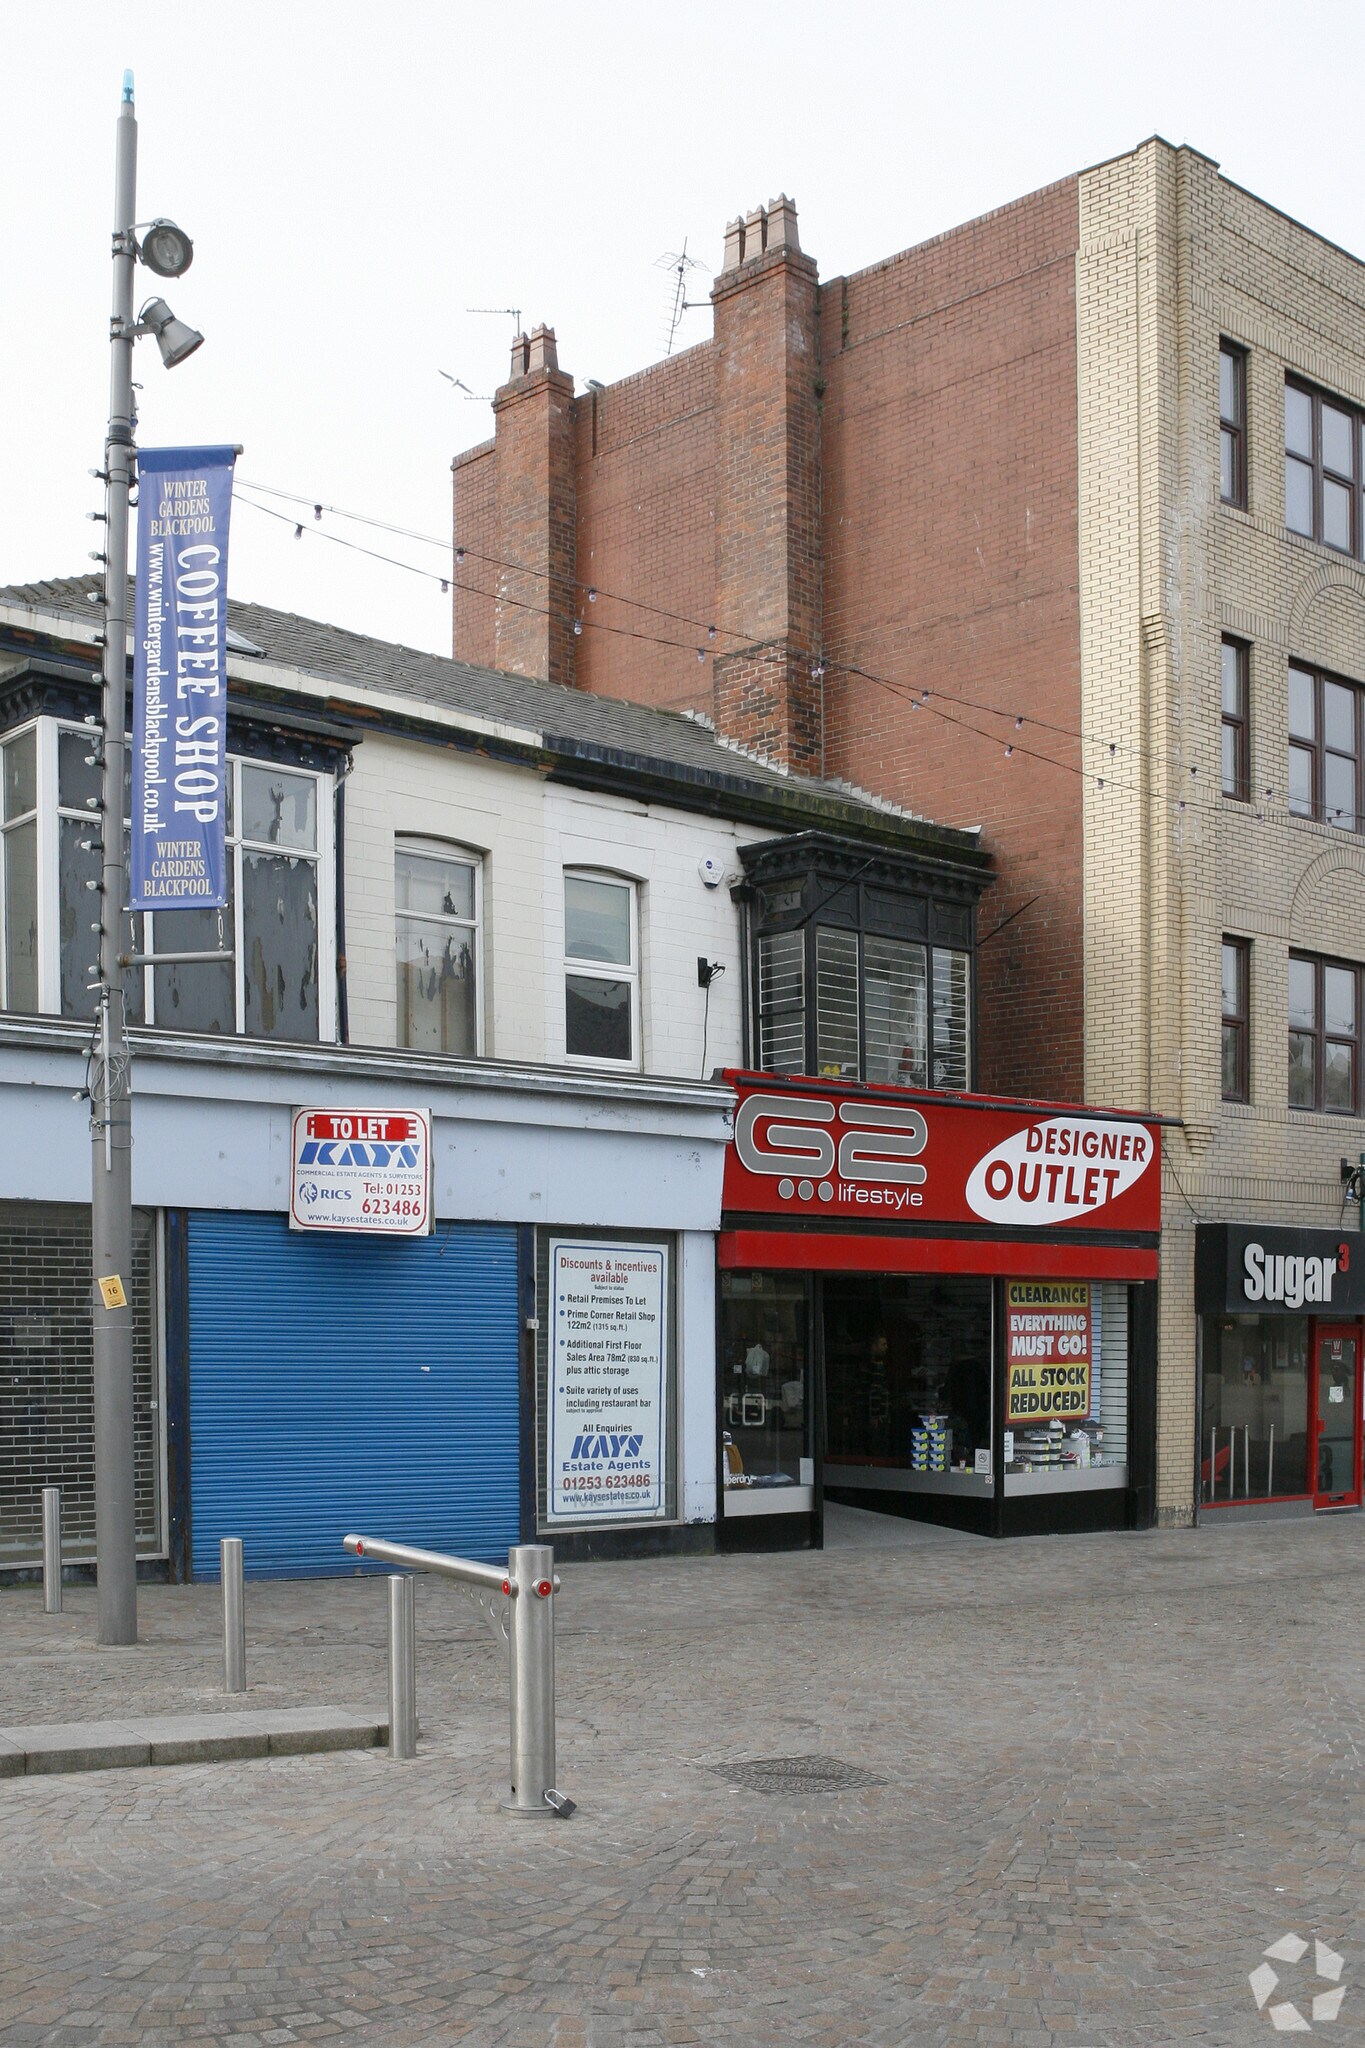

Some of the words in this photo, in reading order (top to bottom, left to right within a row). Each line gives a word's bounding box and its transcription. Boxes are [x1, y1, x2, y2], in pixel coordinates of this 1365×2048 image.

[163, 480, 207, 498] WINTER
[159, 498, 210, 517] GARDENS
[150, 516, 216, 536] BLACKPOOL
[176, 543, 220, 699] COFFEE
[141, 542, 169, 834] www.wintergardensblackpool.co.uk
[174, 716, 219, 823] SHOP
[156, 841, 202, 858] WINTER
[151, 860, 206, 878] GARDENS
[143, 879, 213, 896] BLACKPOOL
[330, 1117, 353, 1139] TO
[357, 1118, 389, 1140] LET
[1026, 1126, 1147, 1162] DESIGNER
[298, 1142, 420, 1168] KAYS
[363, 1182, 384, 1195] Tel:
[386, 1183, 421, 1196] 01253
[984, 1159, 1121, 1206] OUTLET
[320, 1188, 352, 1200] RICS
[838, 1184, 923, 1211] lifestyle
[362, 1198, 421, 1216] 623486
[307, 1213, 409, 1226] www.kaysestates.co.uk
[560, 1257, 603, 1271] Discounts
[605, 1260, 612, 1271] &
[614, 1260, 658, 1273] incentives
[590, 1271, 629, 1284] available
[107, 1286, 119, 1295] 16
[1010, 1285, 1087, 1303] CLEARANCE
[567, 1294, 589, 1304] Retail
[590, 1295, 624, 1305] Premises
[626, 1296, 634, 1305] To
[635, 1297, 646, 1306] Let
[567, 1310, 589, 1319] Prime
[590, 1310, 614, 1320] Corner
[616, 1311, 637, 1320] Retail
[638, 1312, 656, 1322] Shop
[1010, 1314, 1087, 1332] EVERYTHING
[567, 1321, 591, 1330] 122m2
[592, 1323, 609, 1332] (1315
[566, 1340, 604, 1349] Additional
[605, 1340, 622, 1350] First
[623, 1341, 642, 1350] Floor
[1011, 1335, 1055, 1357] MUST
[1057, 1335, 1088, 1356] GO!
[566, 1353, 587, 1362] Sales
[588, 1353, 605, 1362] Area
[606, 1353, 626, 1362] 78m2
[566, 1366, 582, 1376] plus
[583, 1366, 601, 1375] attic
[602, 1367, 630, 1376] storage
[1011, 1368, 1037, 1388] ALL
[1040, 1366, 1086, 1387] STOCK
[566, 1386, 585, 1395] Suite
[586, 1386, 612, 1396] variety
[613, 1386, 621, 1395] of
[566, 1398, 600, 1409] including
[601, 1399, 638, 1408] restaurant
[640, 1398, 652, 1408] bar
[1010, 1390, 1086, 1414] REDUCED!
[582, 1424, 594, 1433] All
[596, 1424, 633, 1433] Enquiries
[570, 1435, 644, 1459] KAYS
[562, 1461, 604, 1472] Estate
[608, 1460, 651, 1472] Agents
[563, 1476, 602, 1491] 01253
[605, 1474, 651, 1489] 623486
[562, 1490, 651, 1503] www.kaysestates.co.uk
